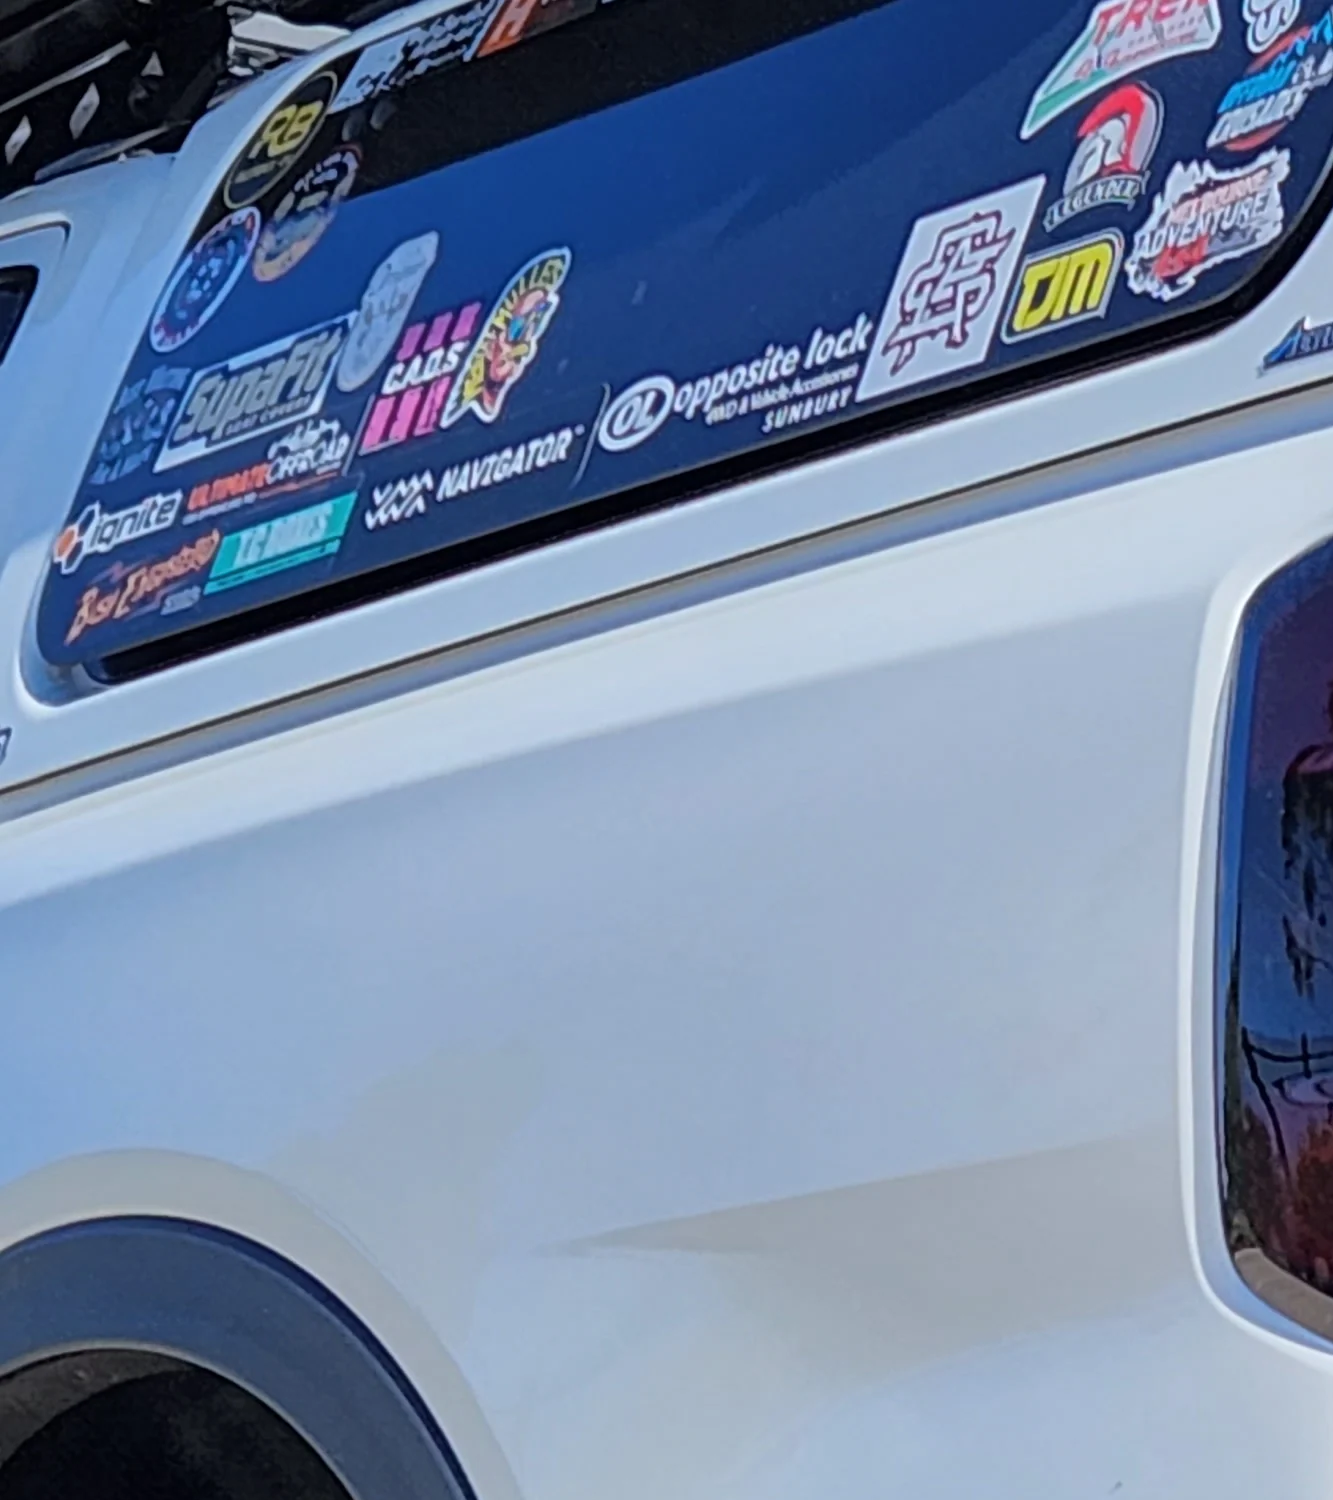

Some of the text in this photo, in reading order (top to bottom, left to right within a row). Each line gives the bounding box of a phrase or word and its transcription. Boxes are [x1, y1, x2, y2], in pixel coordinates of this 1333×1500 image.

[1136, 191, 1270, 257] ADVENTURE
[673, 312, 873, 421] opposite lock
[761, 385, 854, 433] SUNBURY
[436, 426, 573, 503] NAVIGATOR
[89, 496, 179, 547] ignite
